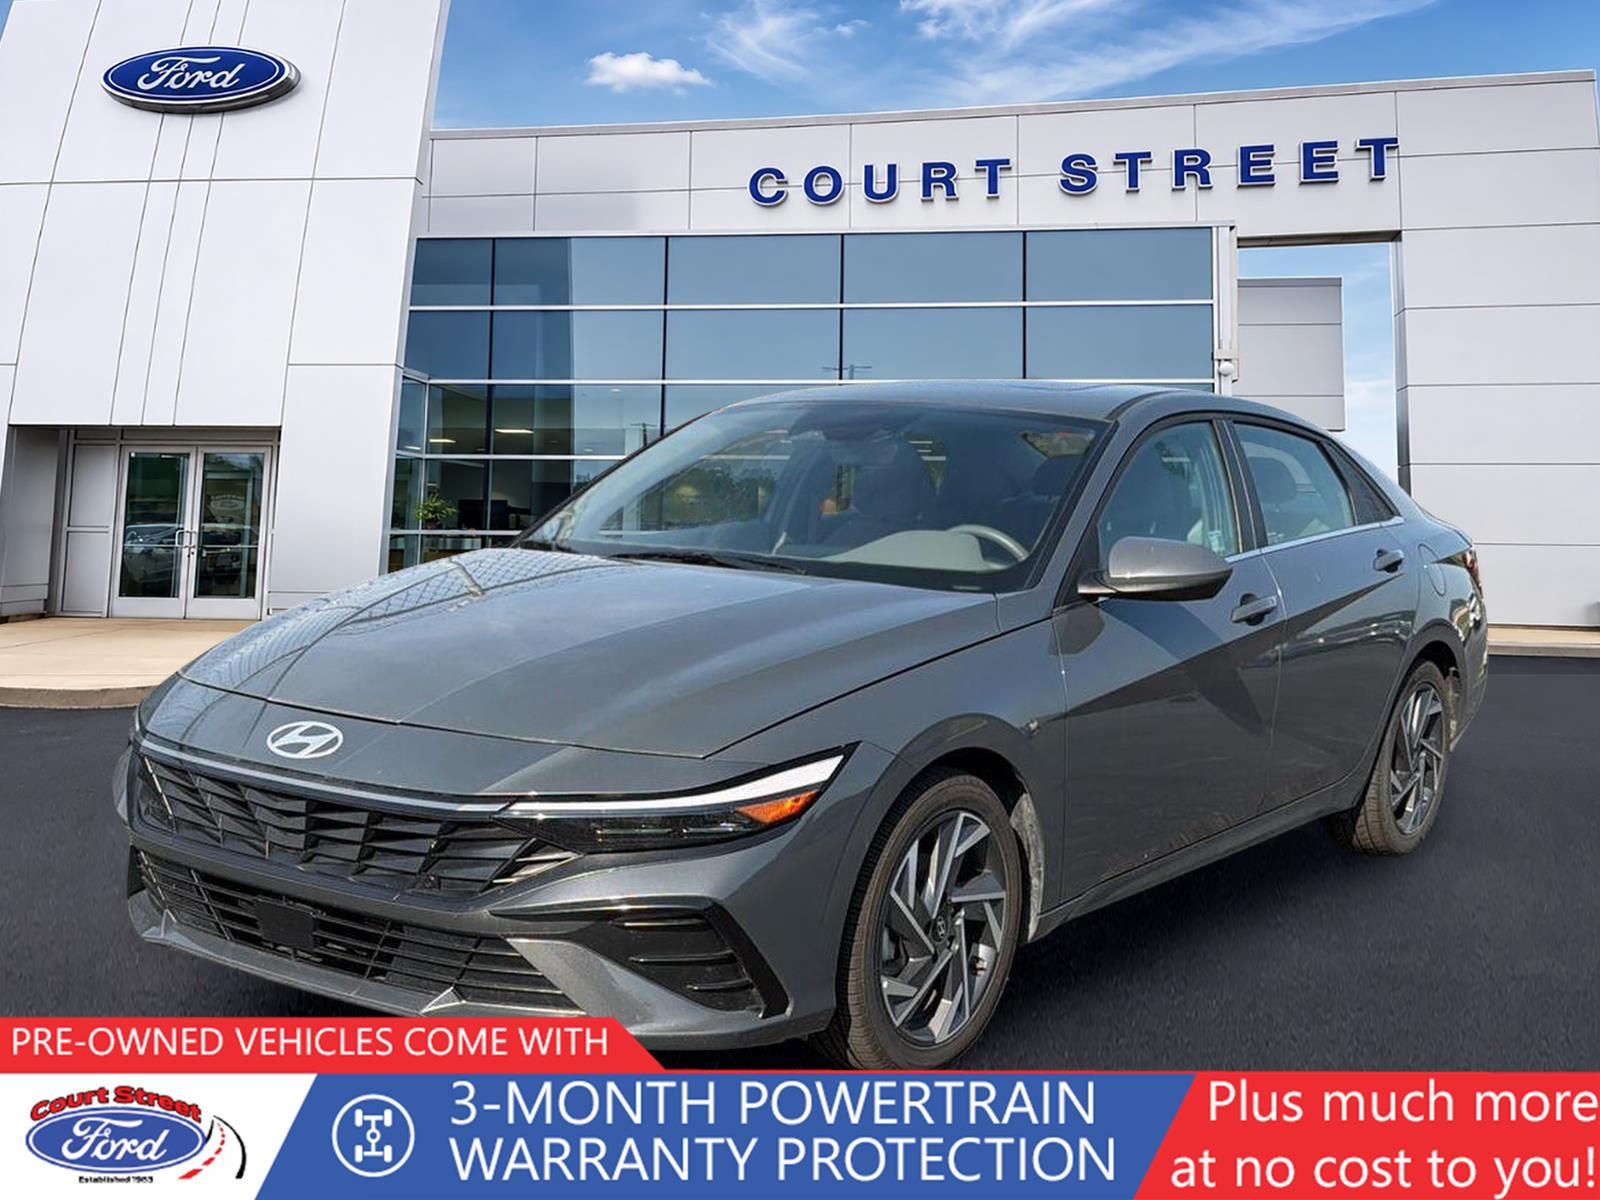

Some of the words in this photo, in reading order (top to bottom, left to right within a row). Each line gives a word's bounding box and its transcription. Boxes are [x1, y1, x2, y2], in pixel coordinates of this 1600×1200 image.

[137, 56, 246, 91] Ford
[747, 157, 1011, 206] COURT
[1059, 136, 1399, 195] STREET
